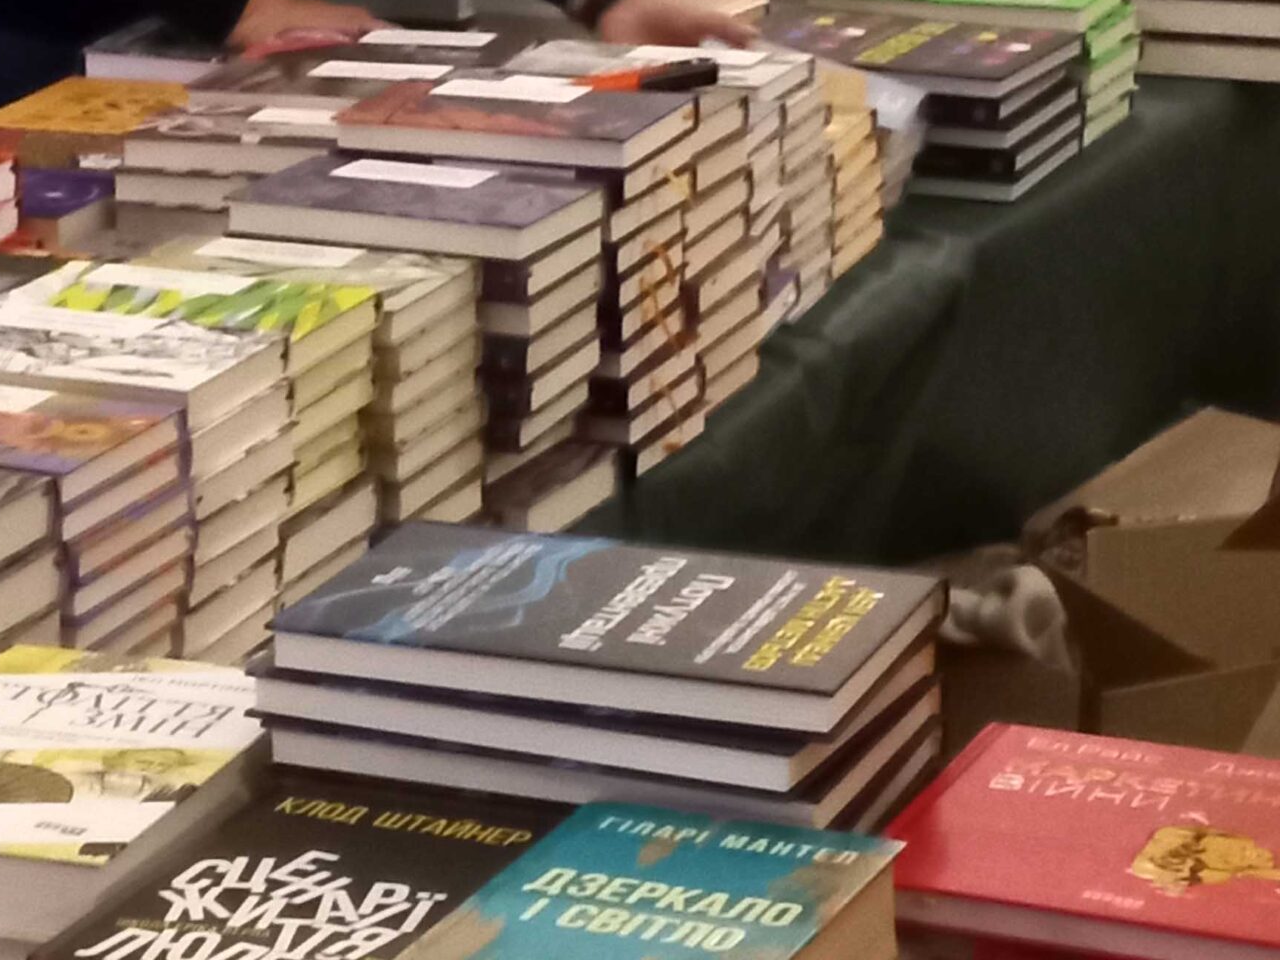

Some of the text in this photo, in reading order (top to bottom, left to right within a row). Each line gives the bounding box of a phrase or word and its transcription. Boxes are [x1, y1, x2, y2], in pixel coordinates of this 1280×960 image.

[274, 796, 533, 846] КЛОД ШТАЙНЕР
[598, 816, 860, 865] ГІЛАРІ МАНТЕЛ
[521, 867, 804, 928] ДЗЕРКАЛО
[519, 897, 746, 953] І СВІТЛО
